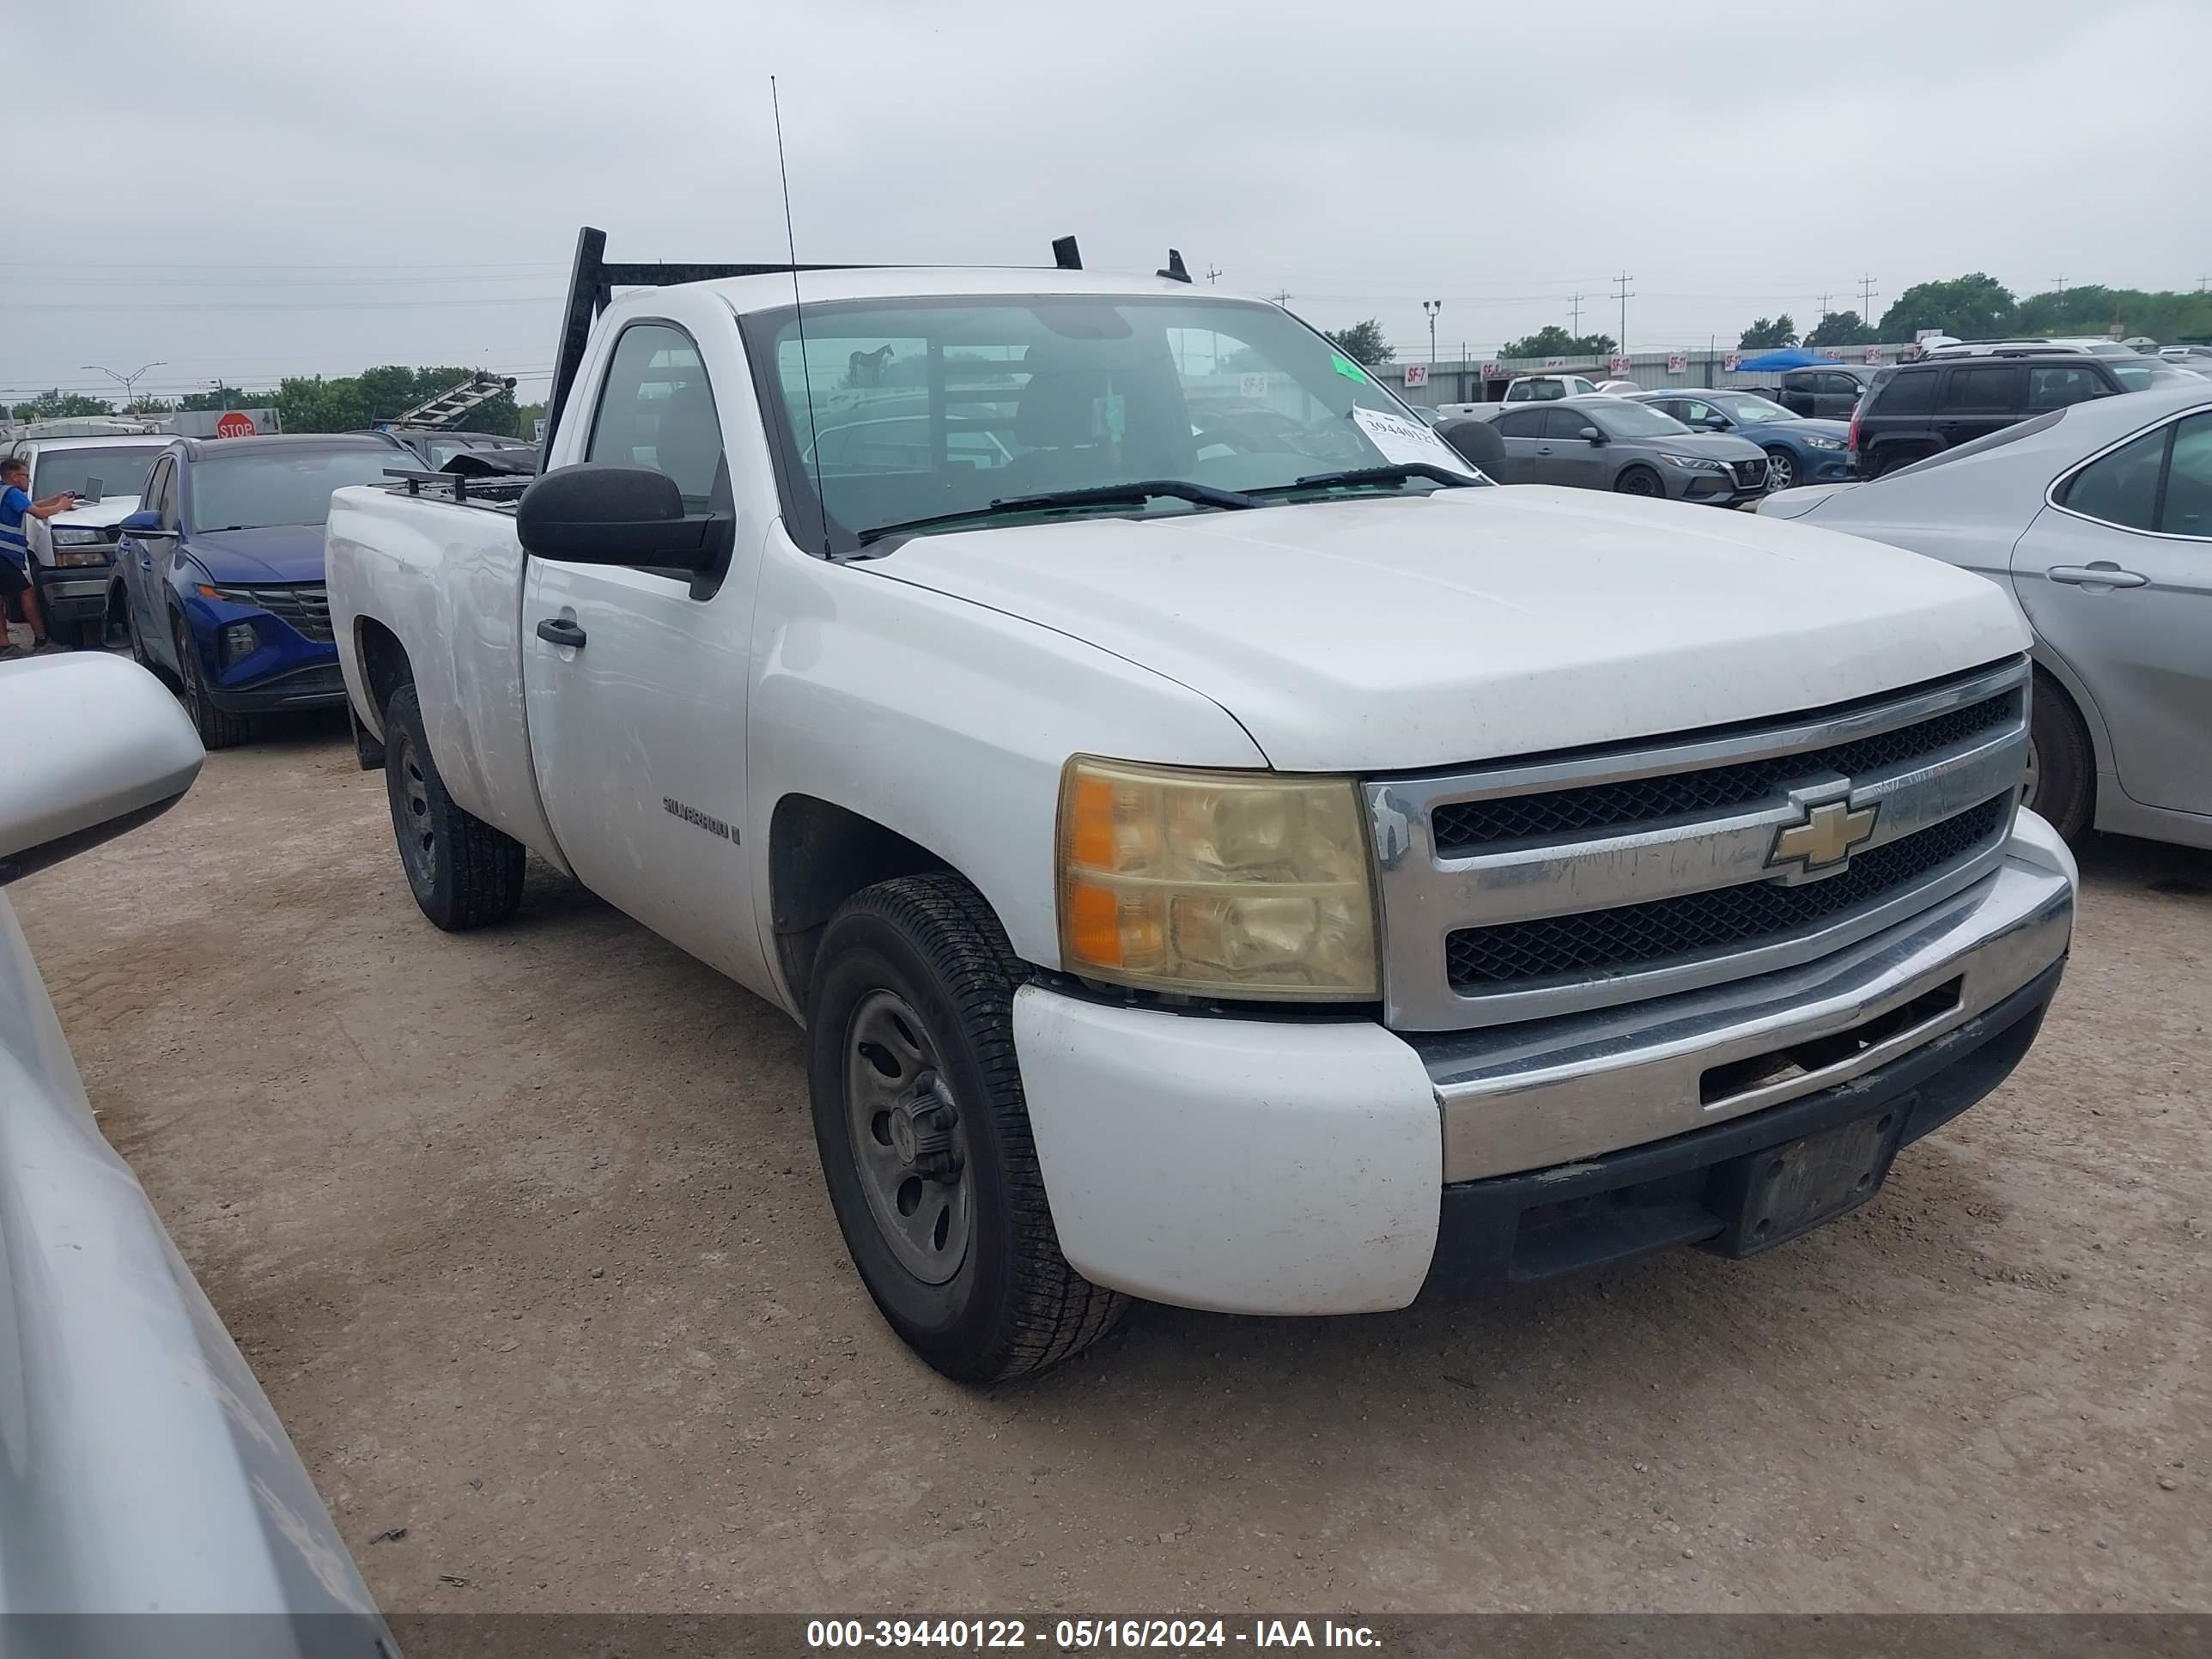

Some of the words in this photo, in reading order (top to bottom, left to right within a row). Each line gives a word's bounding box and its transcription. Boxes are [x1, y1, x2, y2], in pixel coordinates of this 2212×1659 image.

[1613, 358, 1630, 371] SF-10
[1669, 356, 1686, 369] SF-11
[1408, 368, 1426, 382] SF-7
[220, 423, 252, 438] STOP
[663, 796, 729, 839] SILVERADO
